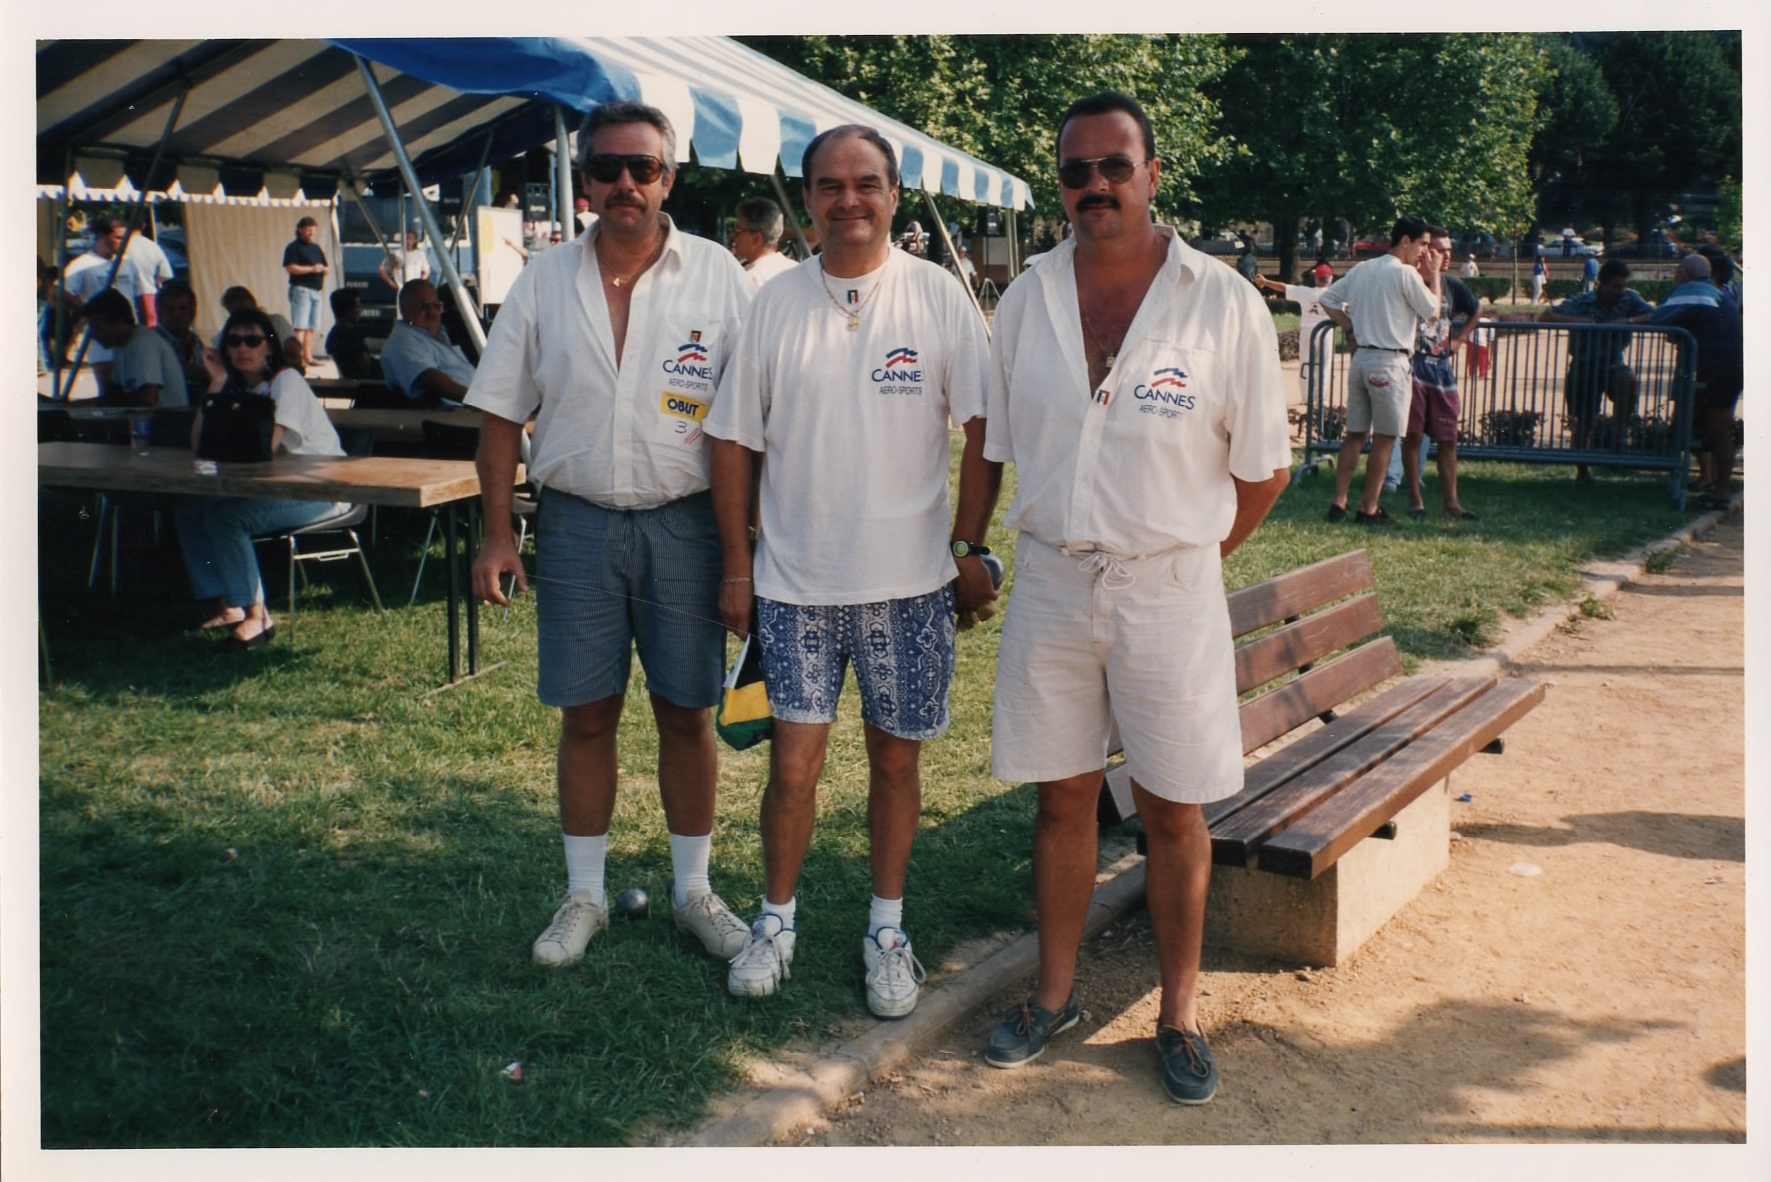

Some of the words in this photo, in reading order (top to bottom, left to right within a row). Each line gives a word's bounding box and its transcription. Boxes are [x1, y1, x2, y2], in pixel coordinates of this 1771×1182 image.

[871, 368, 924, 382] CANNE
[879, 386, 923, 396] AERO-SPORTS
[1133, 384, 1196, 410] CANNES
[667, 398, 699, 416] OBUT
